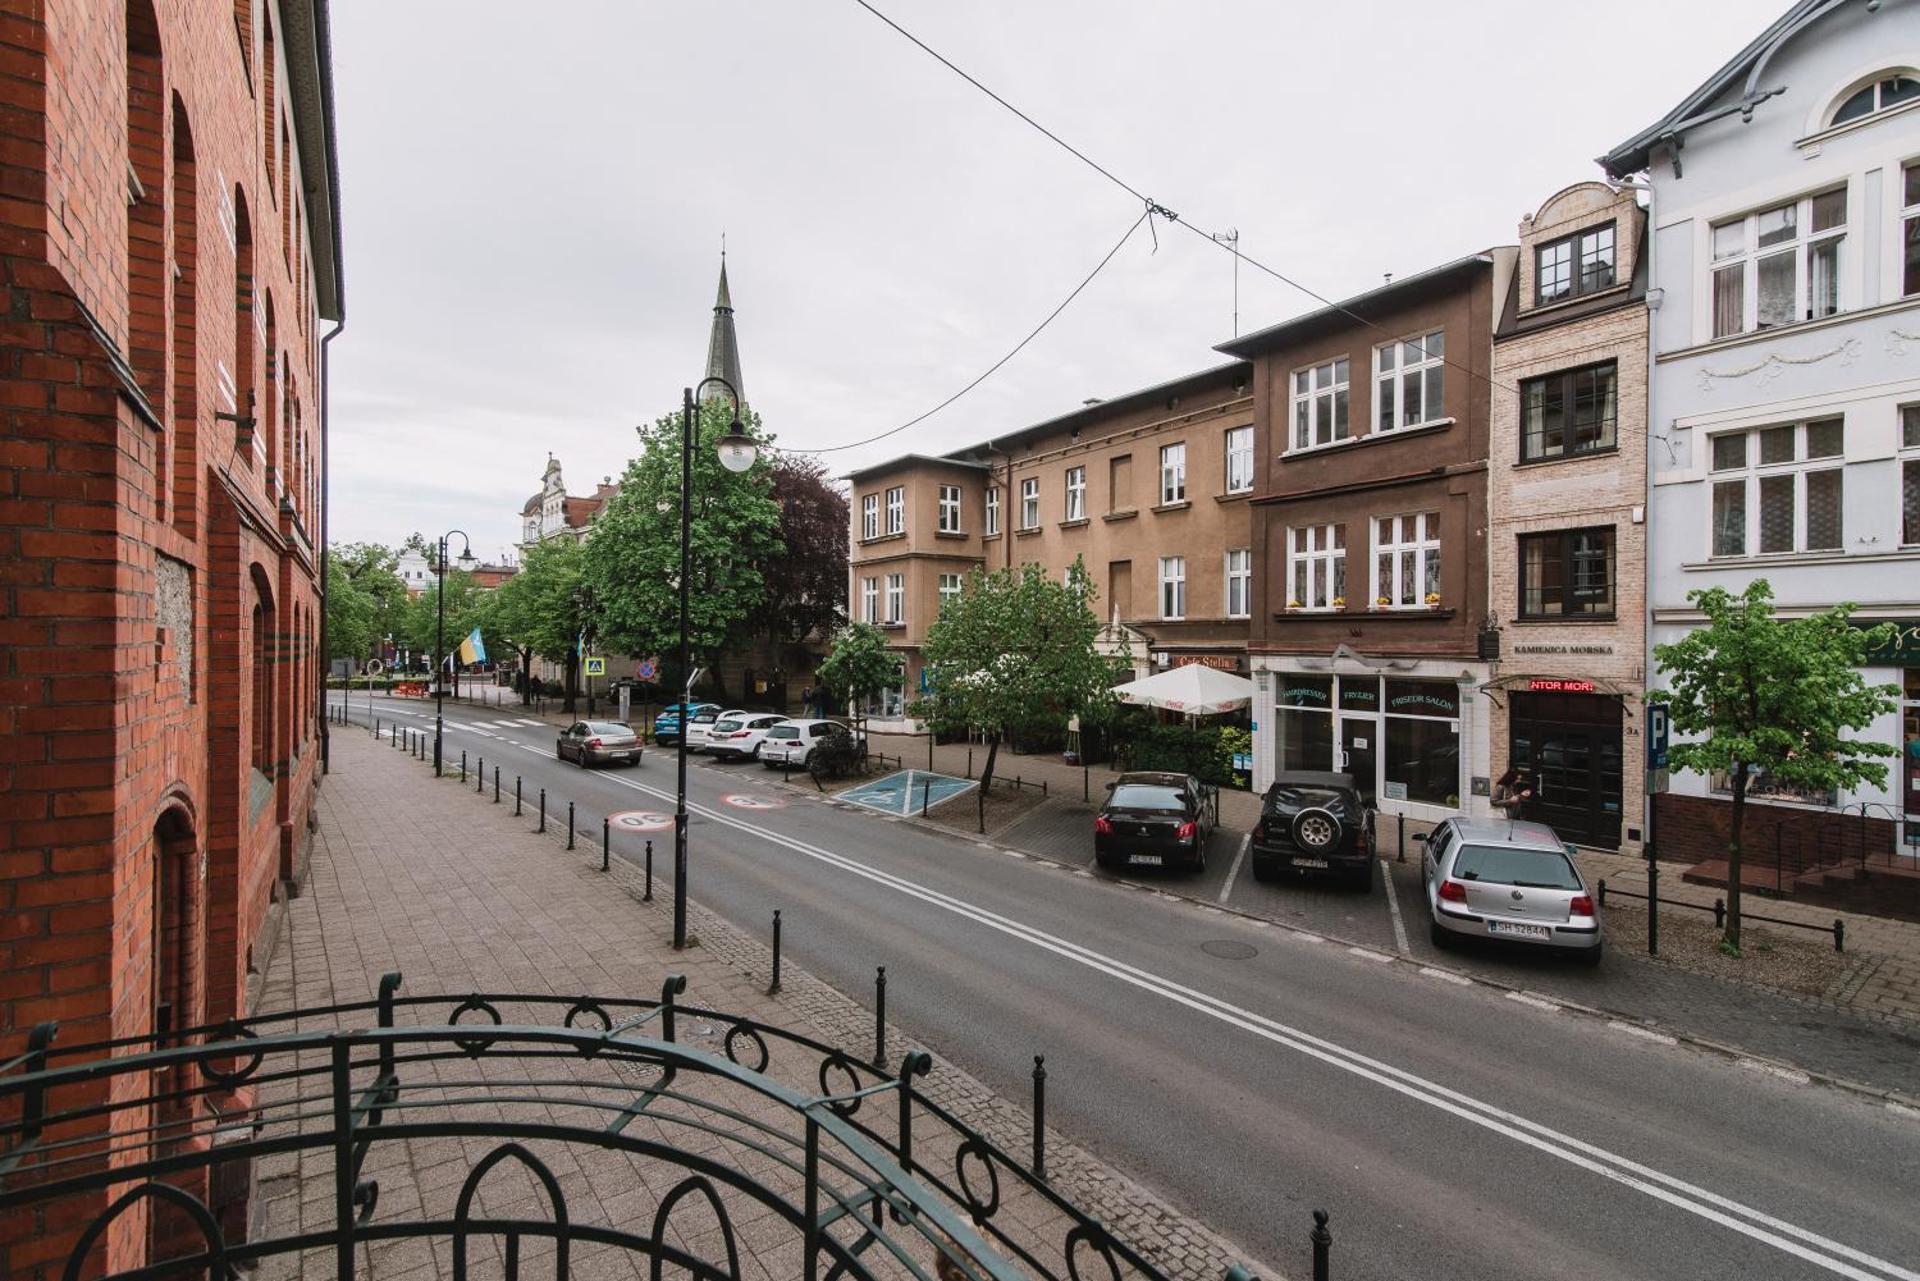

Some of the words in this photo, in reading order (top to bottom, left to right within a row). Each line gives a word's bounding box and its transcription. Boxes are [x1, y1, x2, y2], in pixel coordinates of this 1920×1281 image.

[1514, 645, 1567, 655] KAMIENICA
[1569, 646, 1613, 655] MORSKA
[1425, 695, 1453, 711] SALON
[1652, 711, 1664, 749] P
